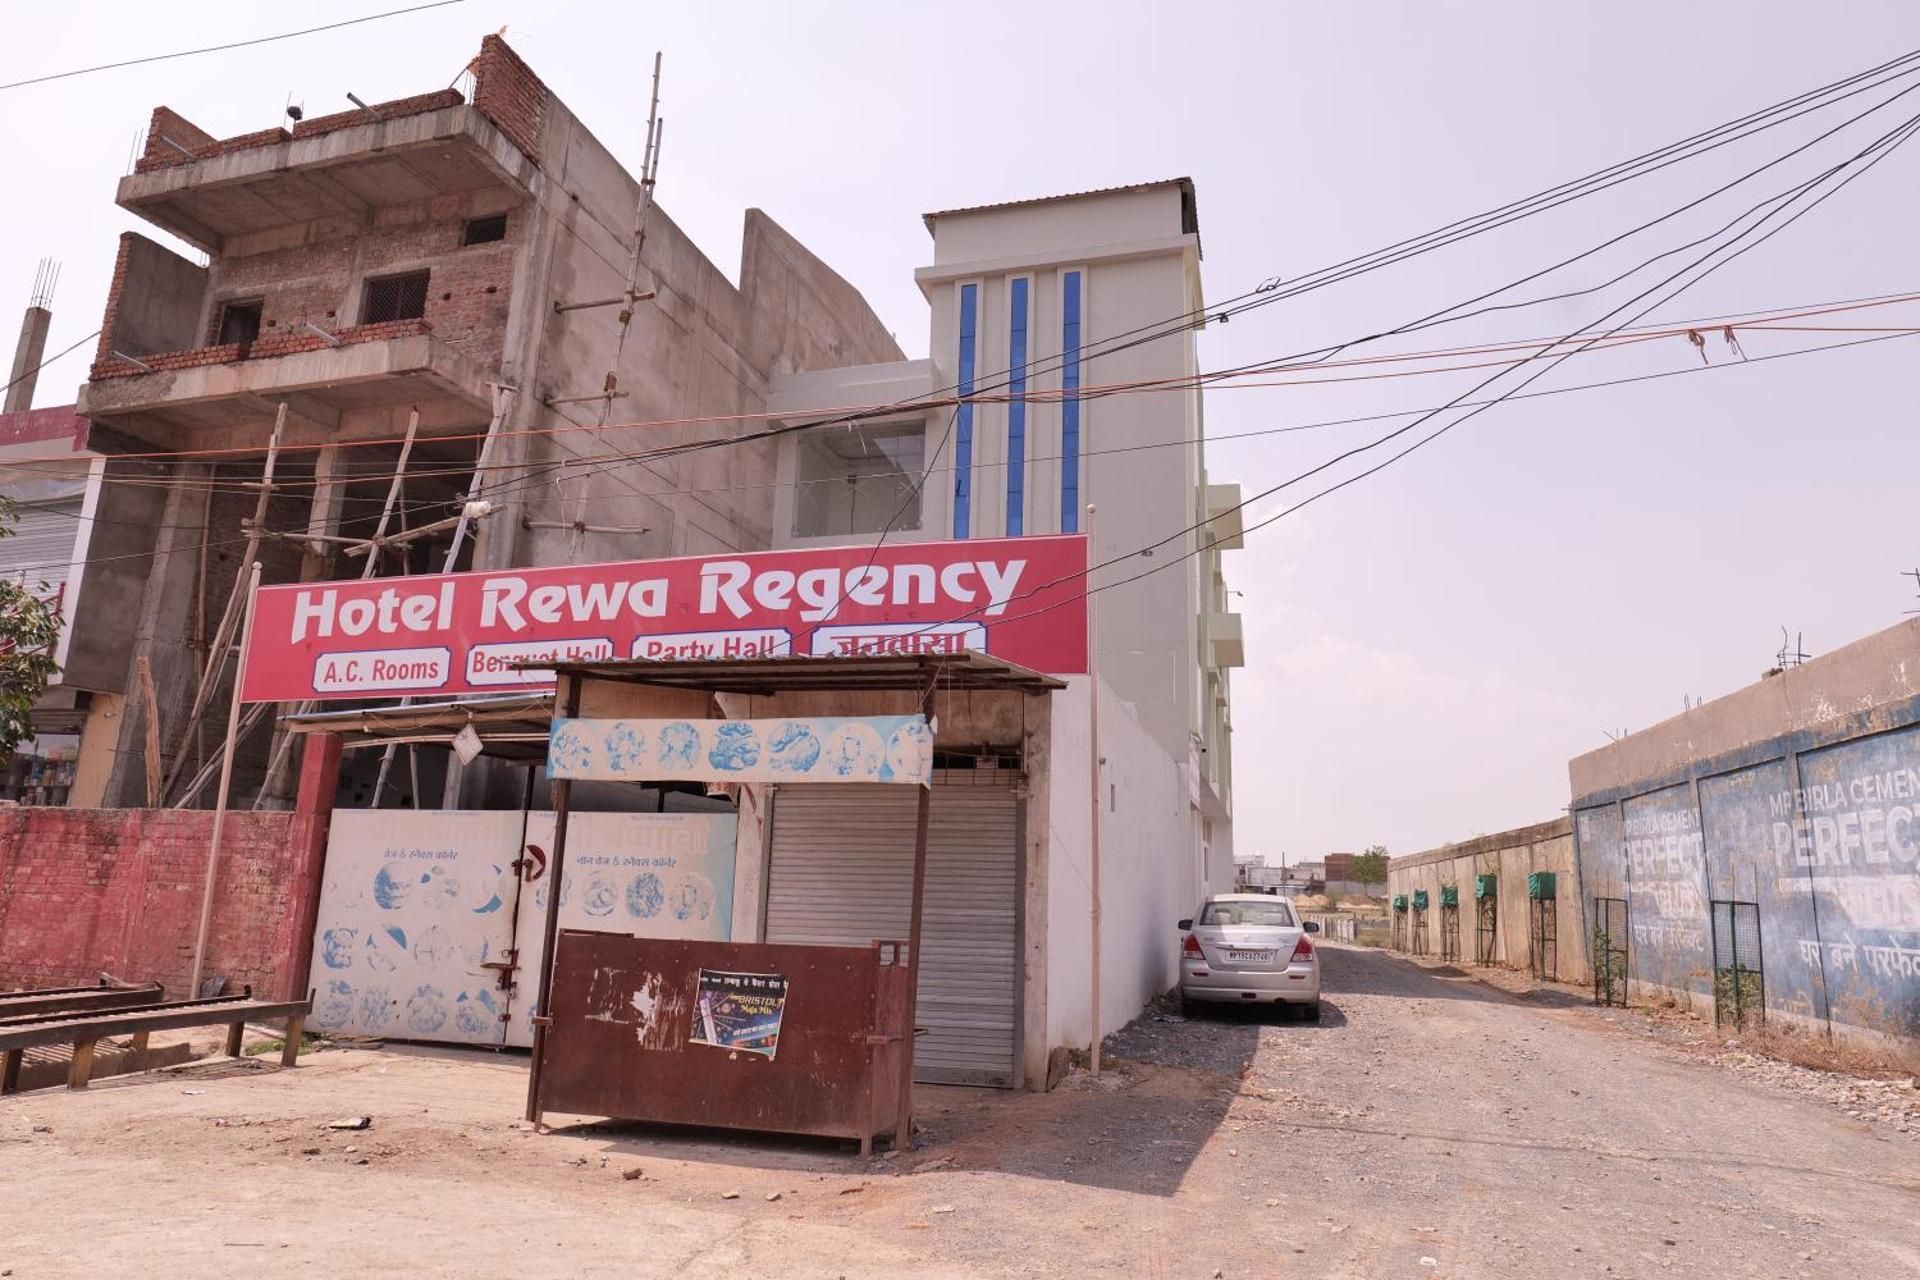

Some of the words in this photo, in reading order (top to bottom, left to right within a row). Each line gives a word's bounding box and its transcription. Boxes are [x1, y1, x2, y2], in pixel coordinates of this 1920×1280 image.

[291, 582, 456, 645] Hotel
[480, 577, 669, 633] Rewa
[699, 558, 1027, 622] Regency
[647, 640, 714, 661] Party
[724, 635, 775, 660] Hall
[323, 660, 363, 684] A.C.
[372, 659, 439, 682] Rooms
[1794, 783, 1847, 813] BIRLA
[1773, 803, 1920, 868] PERFEC
[1798, 940, 1822, 967] घर
